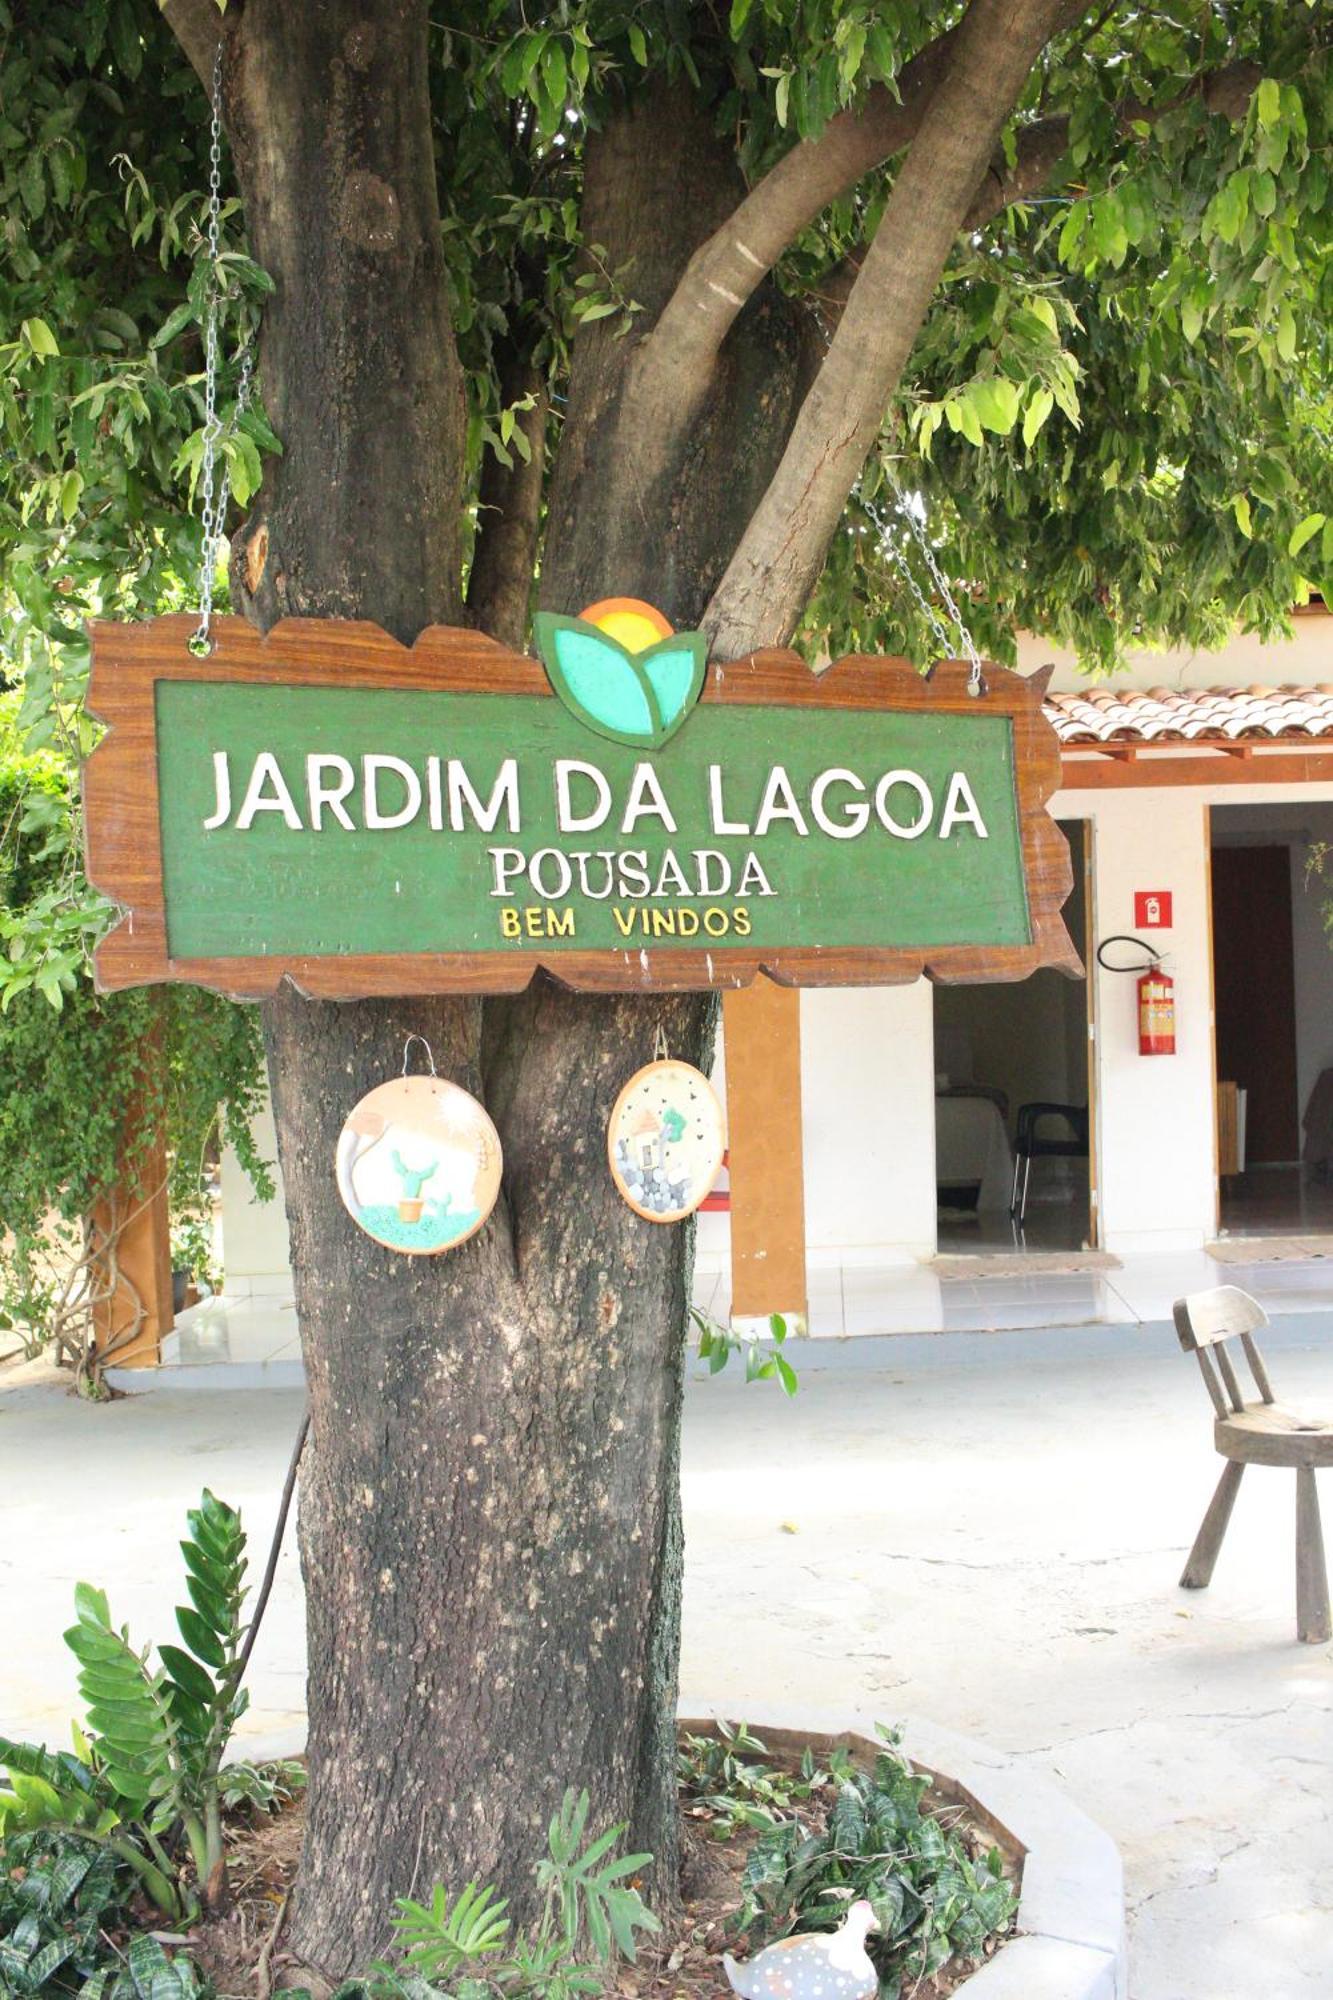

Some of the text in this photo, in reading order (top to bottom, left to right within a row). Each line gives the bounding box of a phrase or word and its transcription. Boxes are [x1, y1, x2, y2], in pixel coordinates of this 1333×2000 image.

[202, 750, 989, 840] JARDIM DA LAGOA
[487, 847, 779, 900] POUSADA
[499, 906, 752, 938] BEM VINDOS
